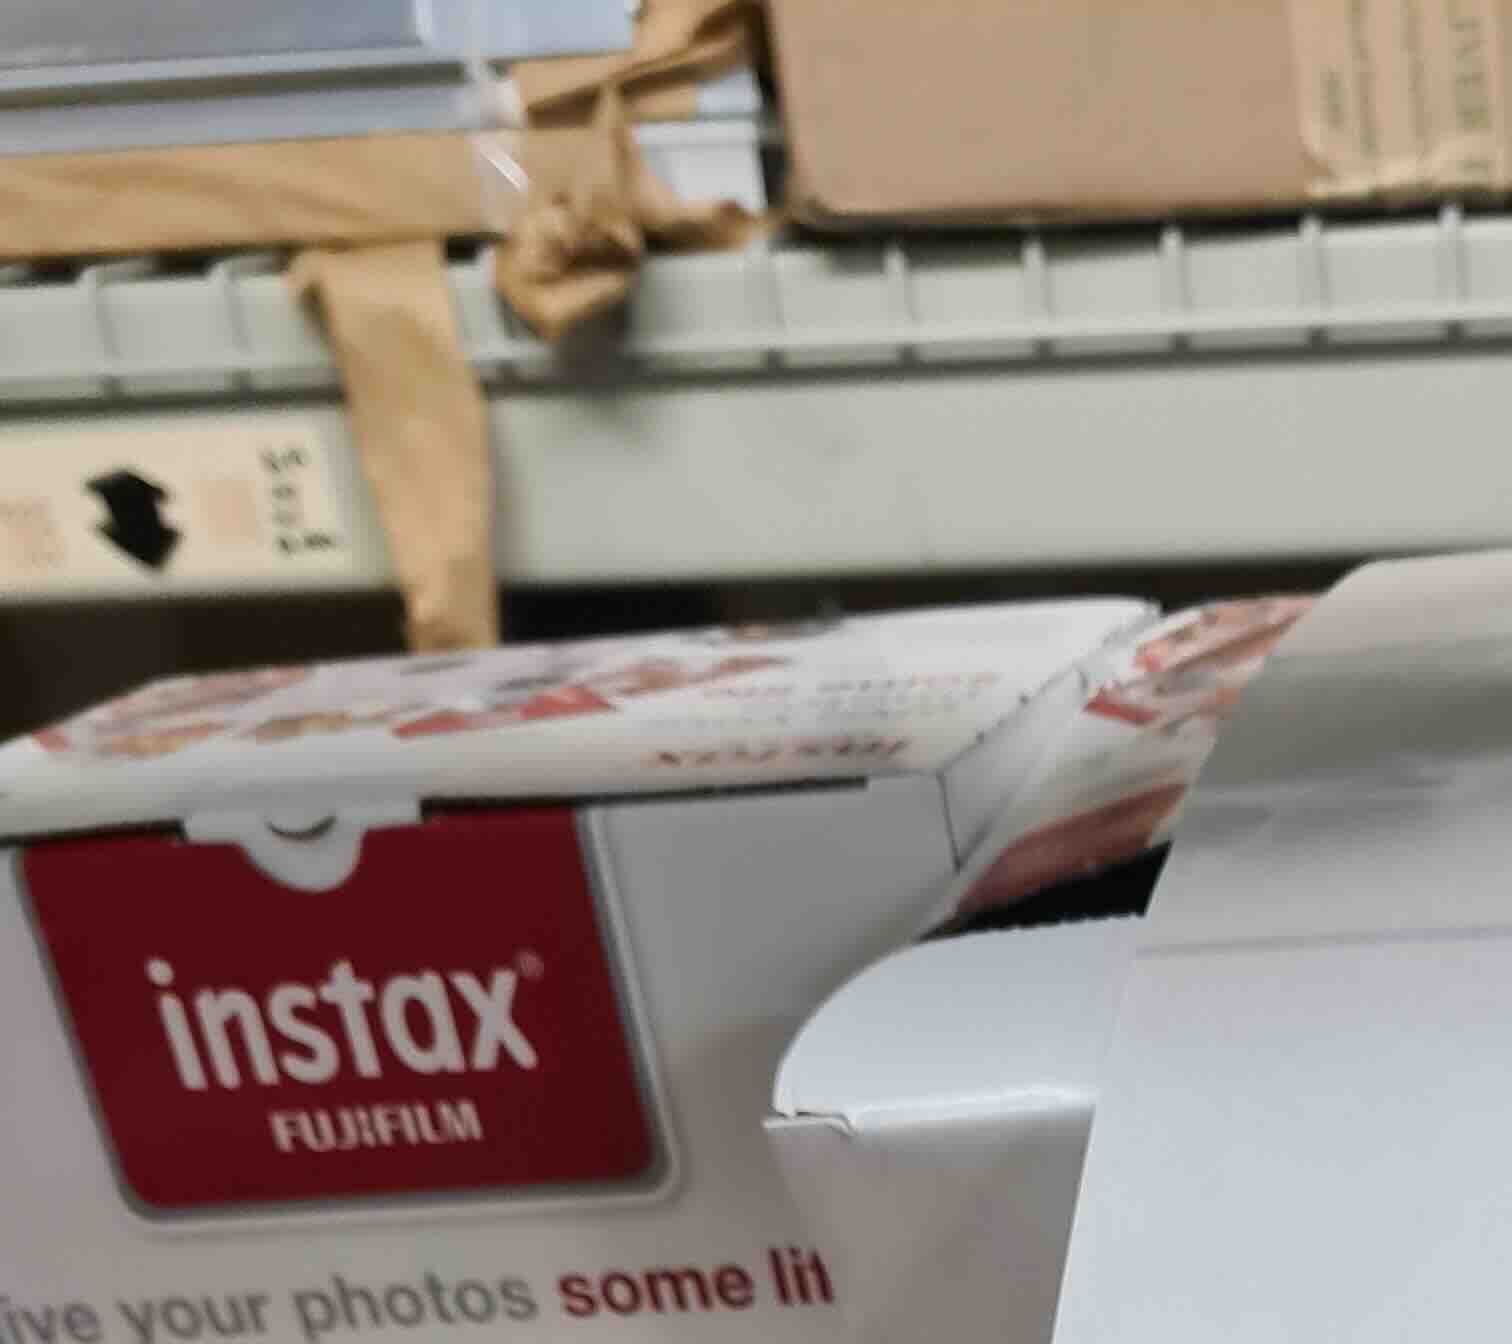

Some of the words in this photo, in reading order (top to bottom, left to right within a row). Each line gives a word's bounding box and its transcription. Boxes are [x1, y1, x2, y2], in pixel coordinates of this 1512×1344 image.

[145, 957, 538, 1091] instax
[269, 1099, 483, 1153] FUJIFILM
[557, 1260, 755, 1319] some
